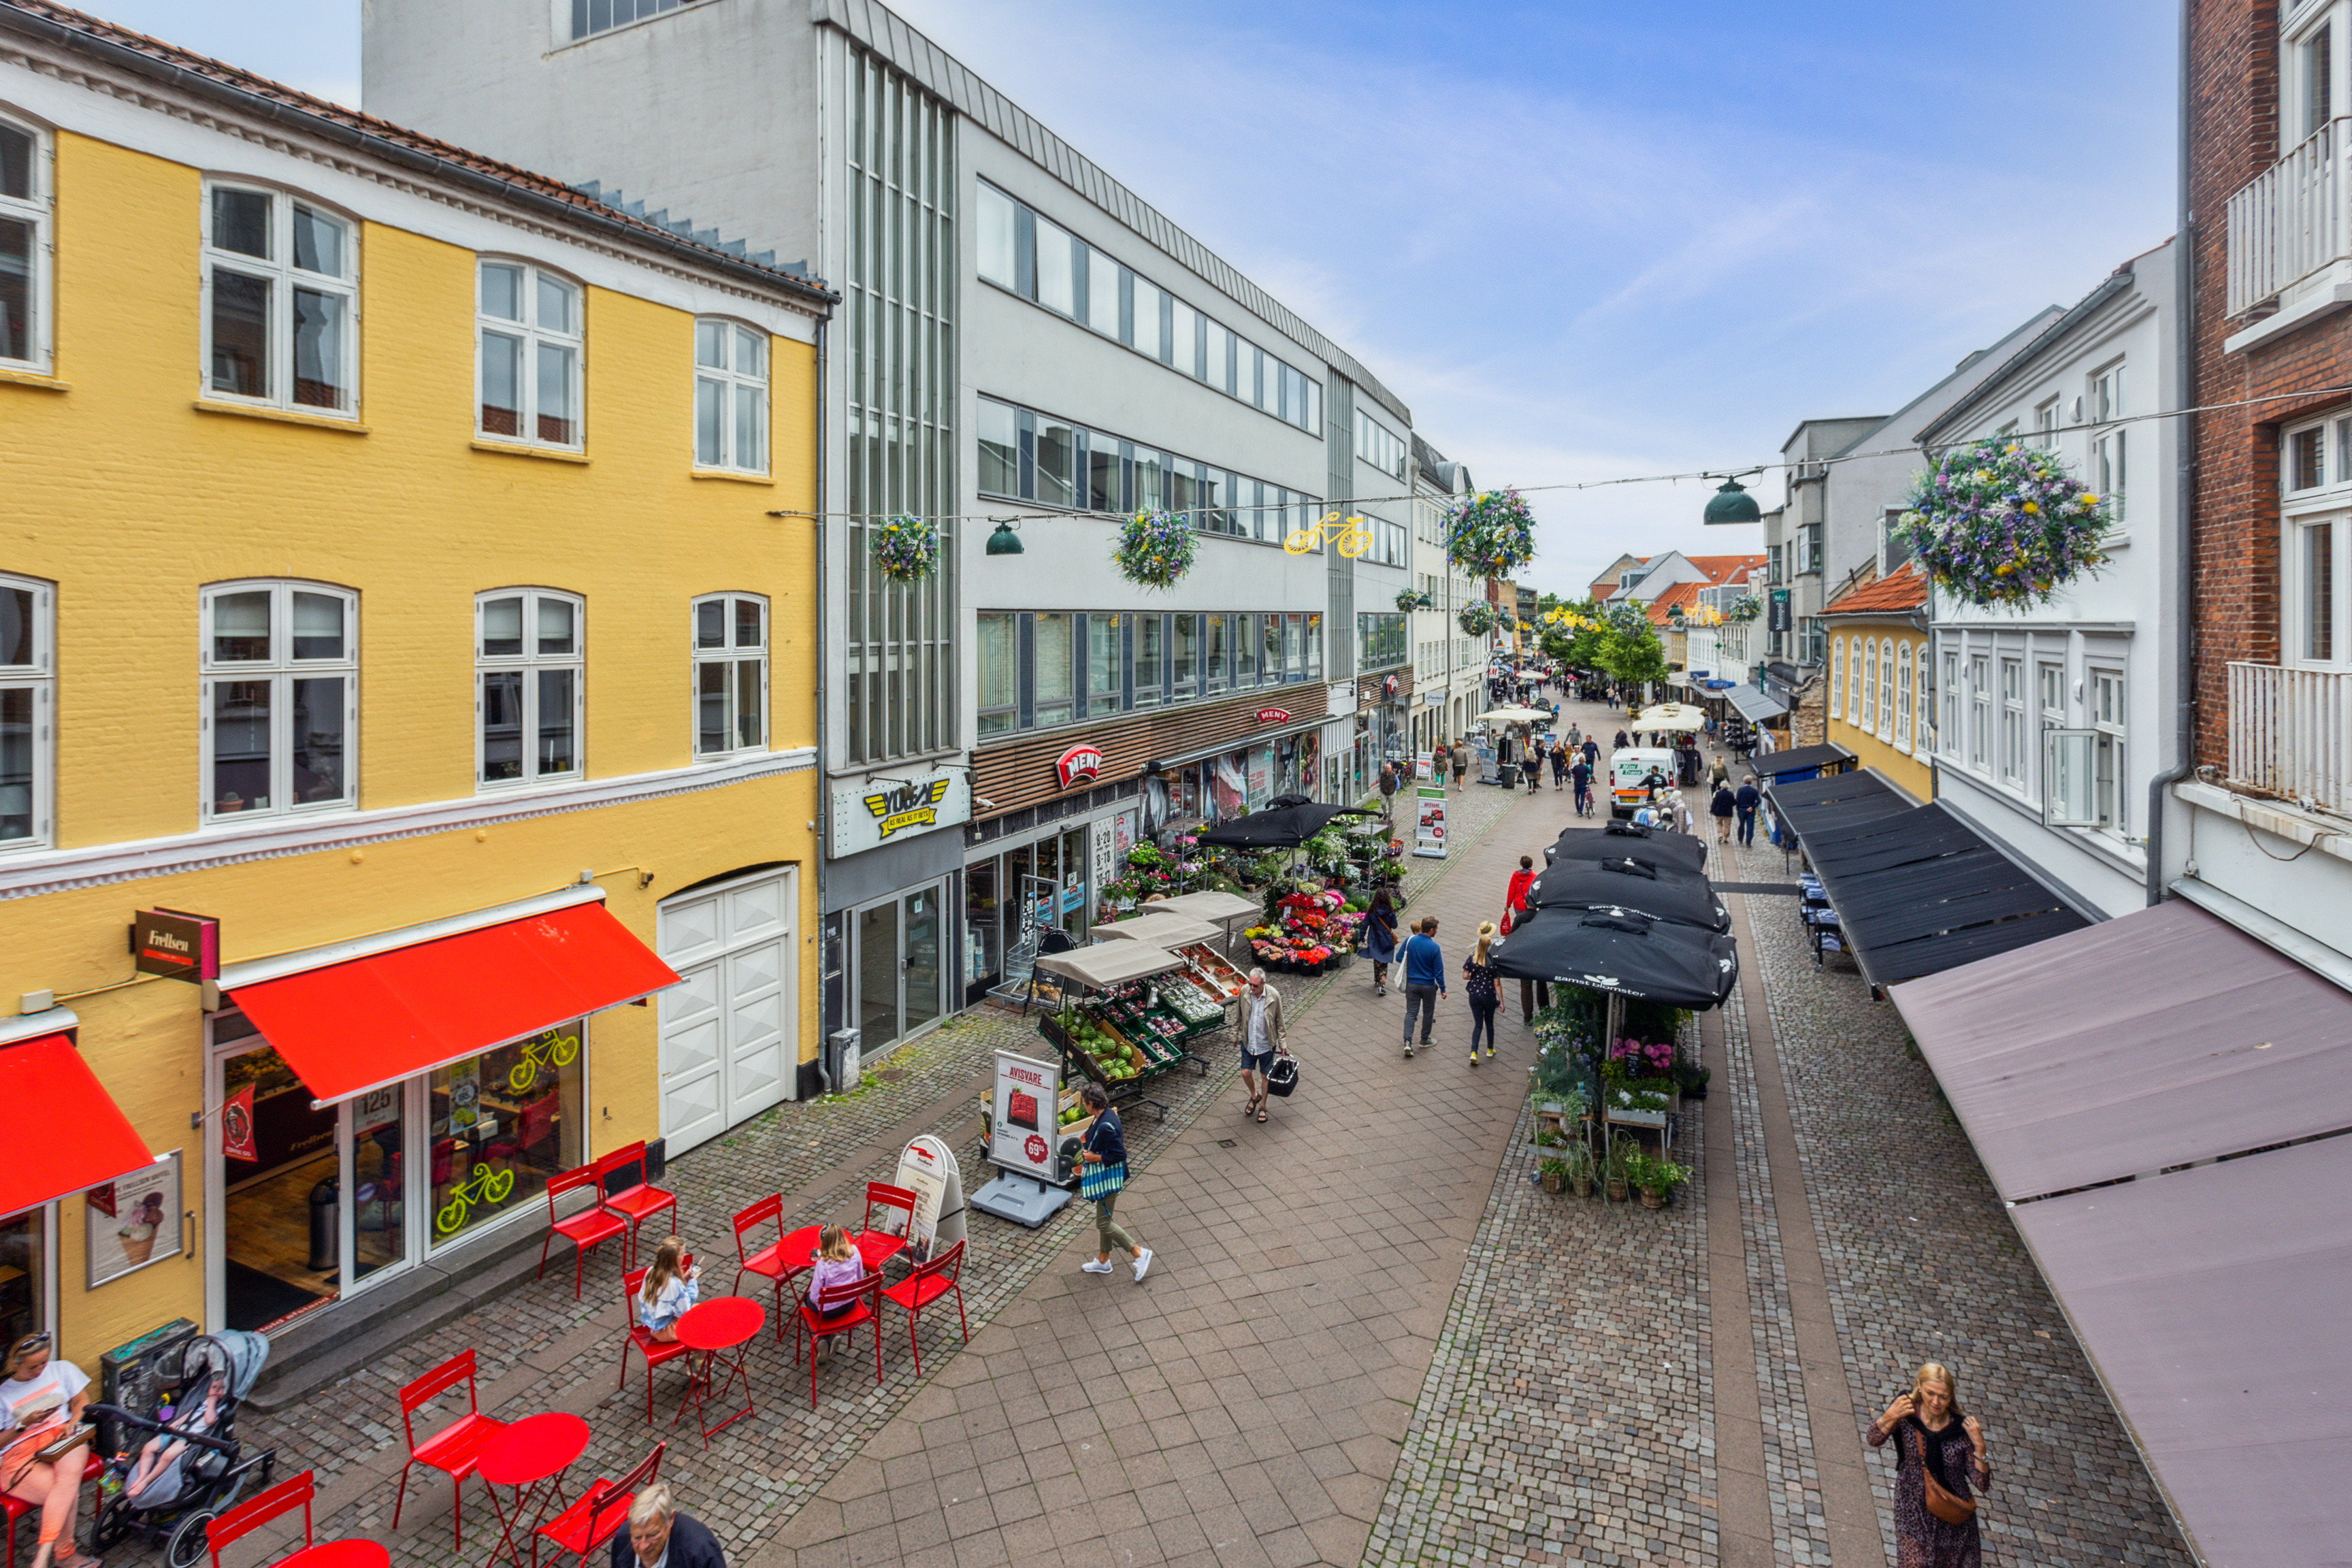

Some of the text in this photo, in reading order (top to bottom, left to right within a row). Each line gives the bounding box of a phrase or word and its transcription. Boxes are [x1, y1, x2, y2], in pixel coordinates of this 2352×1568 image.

[1776, 603, 1784, 630] Monopol
[1261, 711, 1286, 719] MENY
[1066, 753, 1102, 777] MENY
[896, 816, 906, 824] REAL
[1096, 830, 1110, 847] 8-20
[1096, 850, 1110, 866] 8-18
[148, 930, 189, 952] Frellsen
[1554, 975, 1646, 998] gamst blomster
[1009, 1066, 1043, 1085] AVISVARE
[361, 1088, 391, 1116] 125
